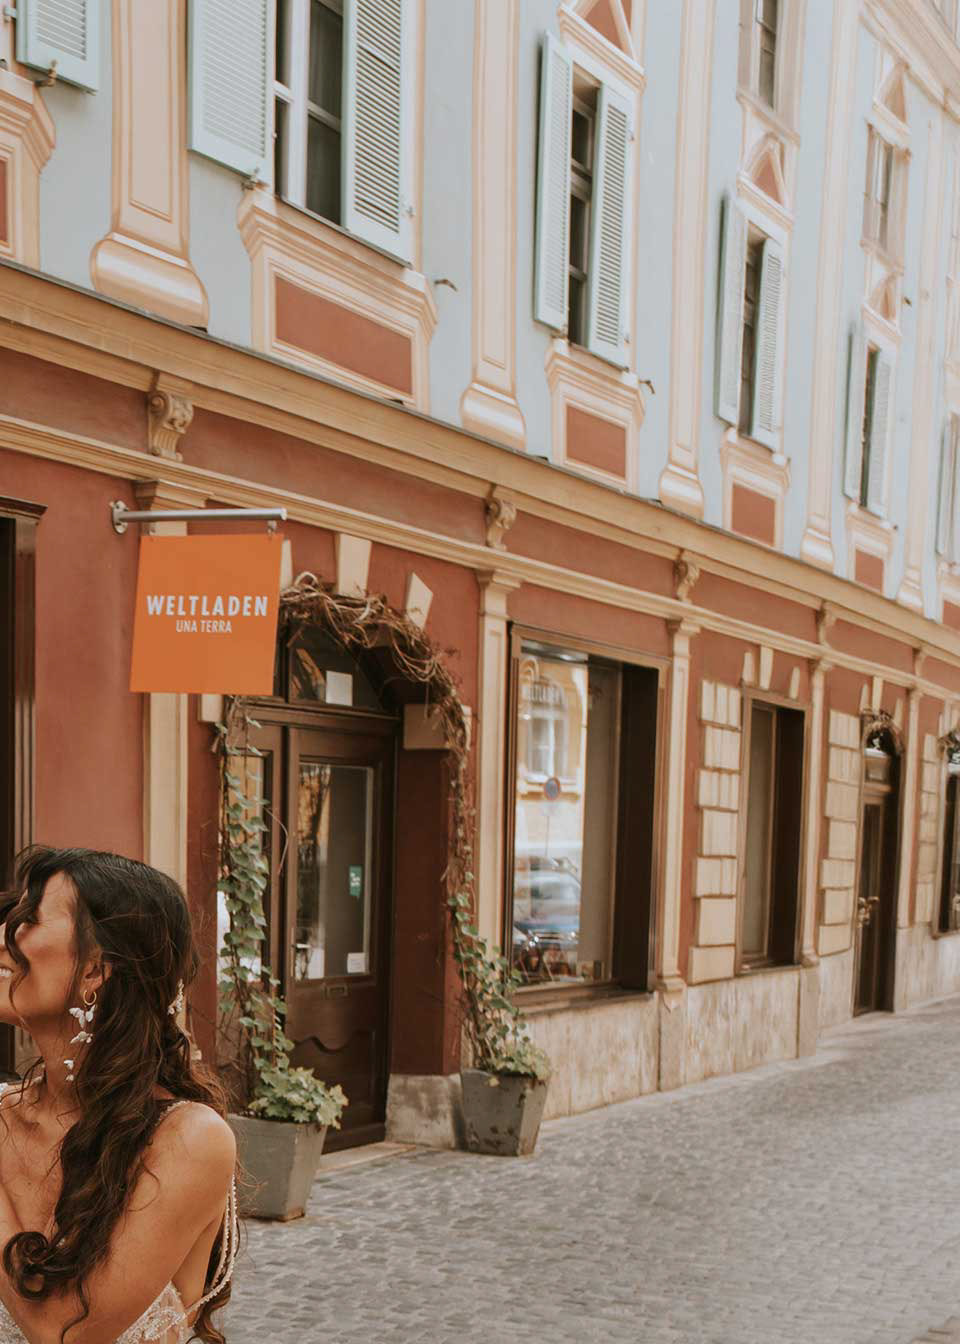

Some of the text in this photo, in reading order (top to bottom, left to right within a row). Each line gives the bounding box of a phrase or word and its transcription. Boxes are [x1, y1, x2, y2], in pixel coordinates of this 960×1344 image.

[146, 595, 268, 617] WELTLADEN
[176, 620, 233, 633] UNA TERRA
